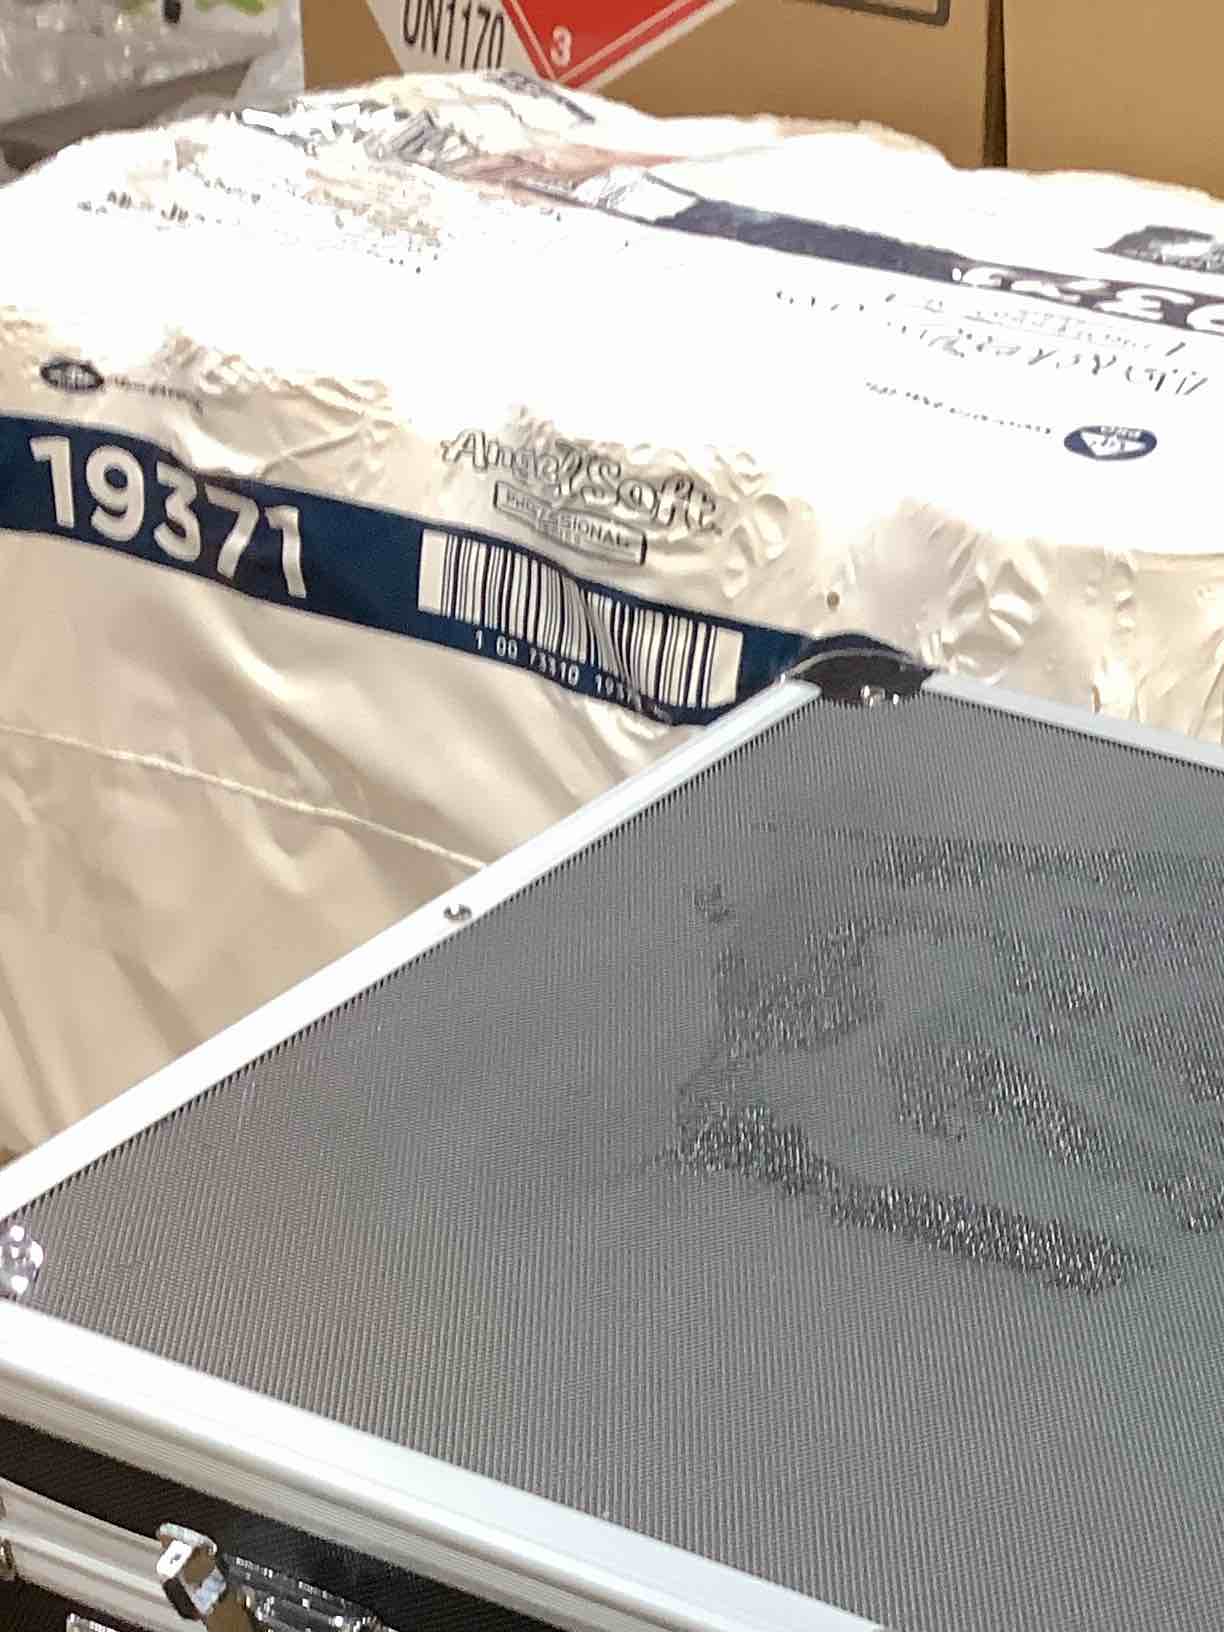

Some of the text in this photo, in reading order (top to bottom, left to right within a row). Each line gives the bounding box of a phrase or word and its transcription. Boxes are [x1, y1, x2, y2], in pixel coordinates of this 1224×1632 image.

[402, 0, 505, 71] UN1170
[550, 24, 572, 69] 3
[28, 433, 308, 599] 19371
[580, 453, 723, 536] Soft
